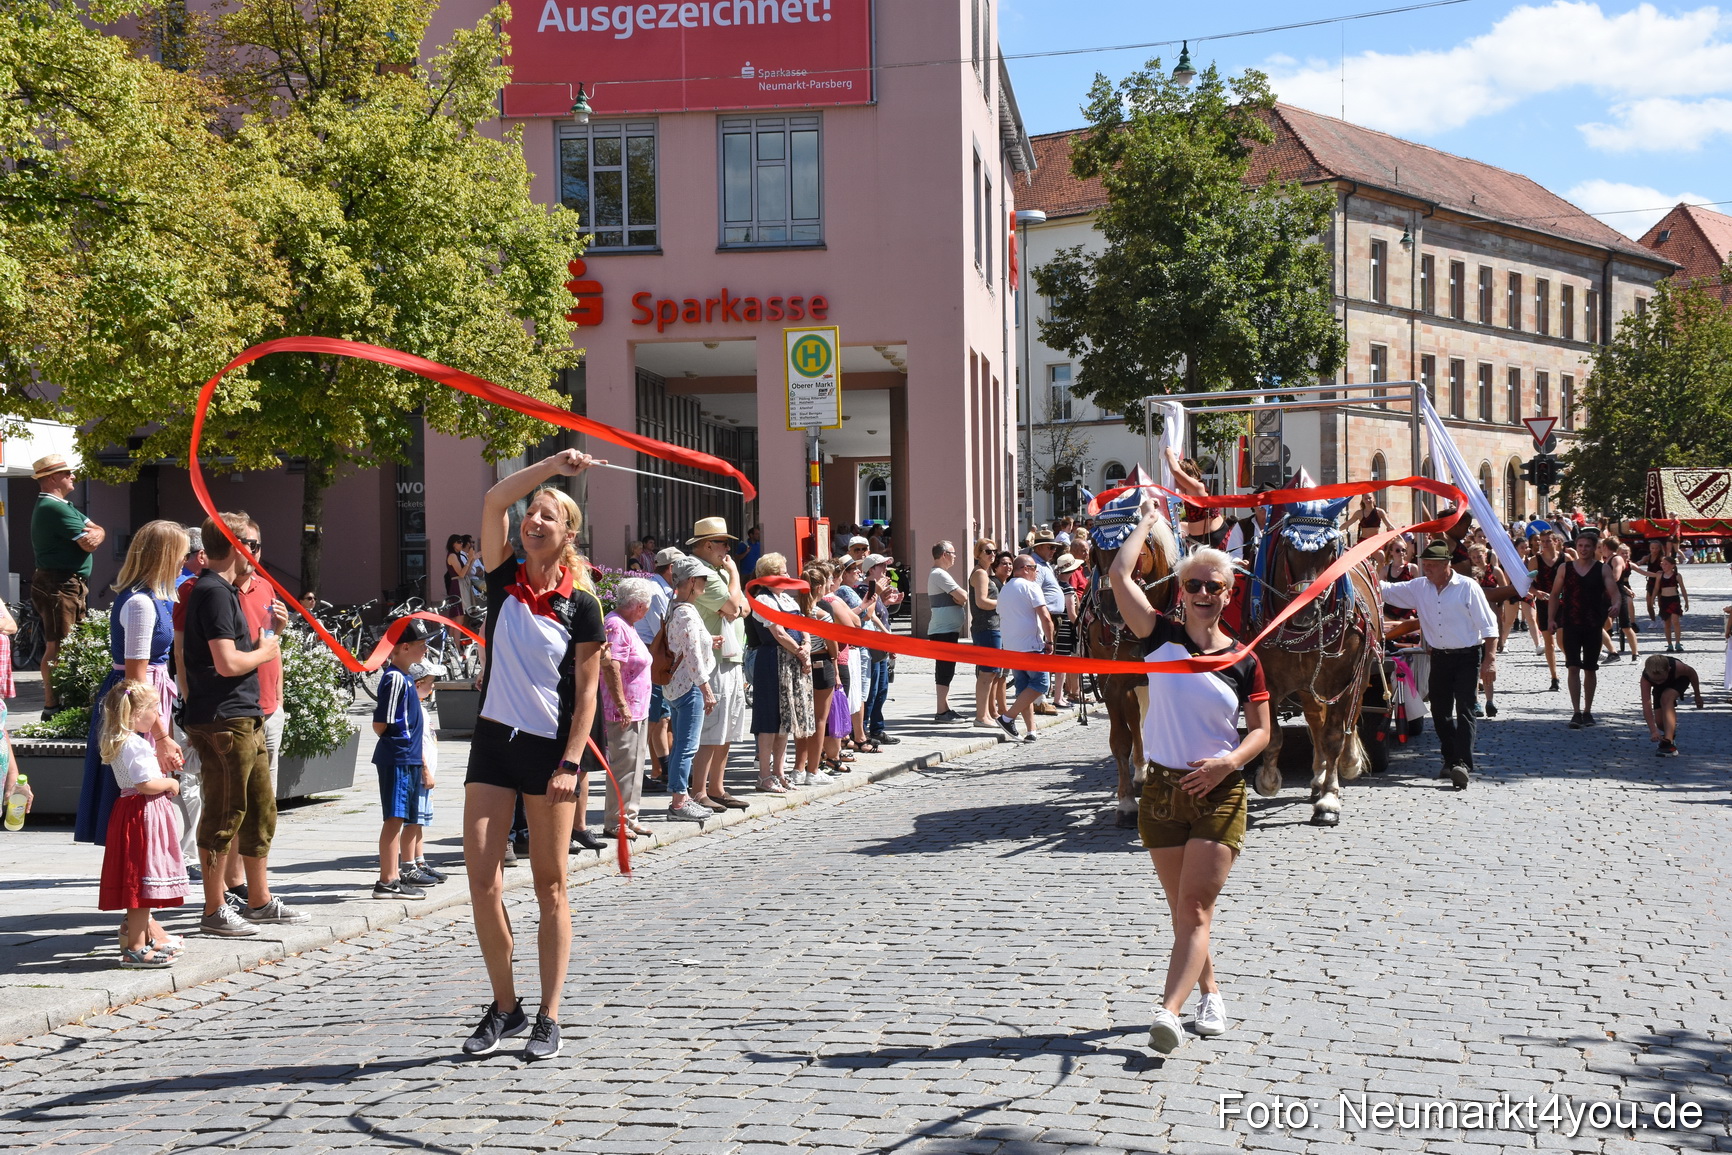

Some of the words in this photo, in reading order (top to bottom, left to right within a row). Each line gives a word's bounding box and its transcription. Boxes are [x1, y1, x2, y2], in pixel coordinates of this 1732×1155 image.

[537, 0, 832, 40] Ausgezeichnet!
[758, 68, 808, 79] Sparkasse
[758, 79, 853, 91] Neumarkt-Parsberg
[631, 287, 829, 333] Sparkasse
[802, 345, 821, 367] H
[396, 482, 425, 494] wo
